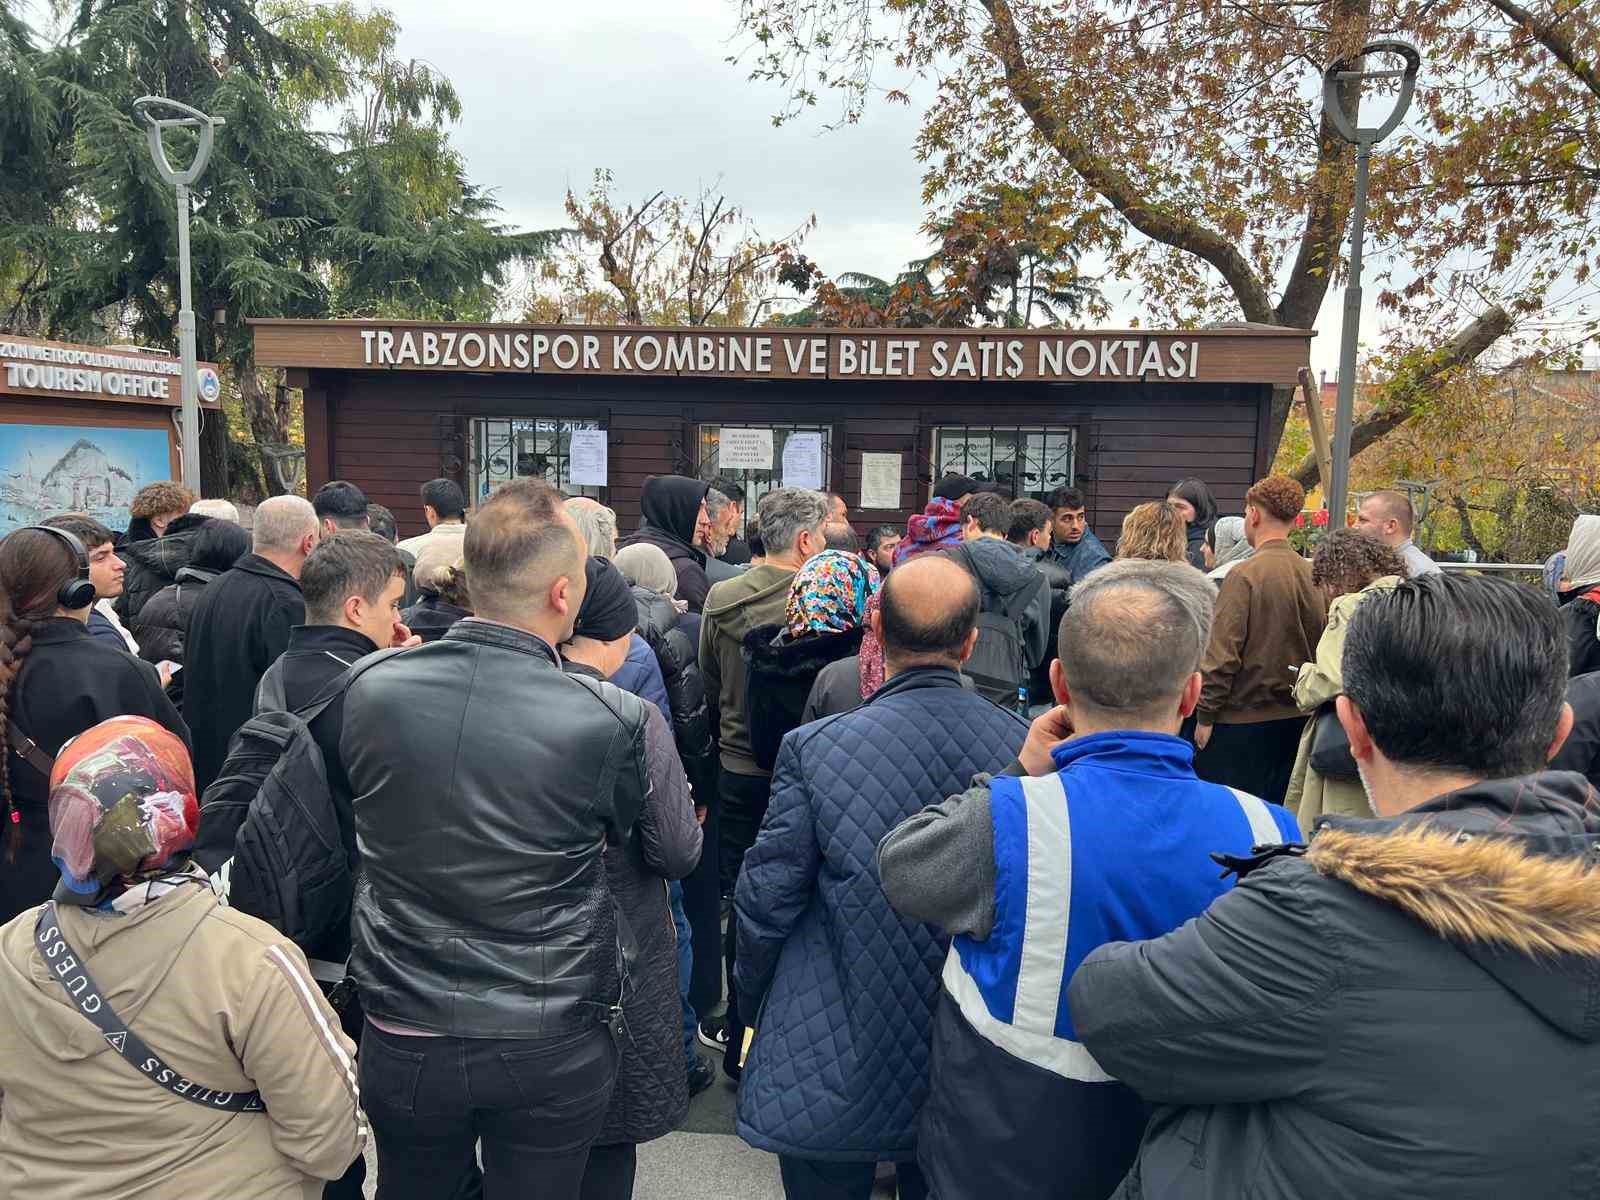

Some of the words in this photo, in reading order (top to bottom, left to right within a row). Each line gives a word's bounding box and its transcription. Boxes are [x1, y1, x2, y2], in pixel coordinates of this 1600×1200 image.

[30, 345, 126, 369] METROPOLITAN
[360, 331, 600, 370] TRABZONSPOR
[783, 338, 827, 374] VE
[1039, 340, 1199, 379] NOKTASI
[4, 362, 102, 393] TOURISM
[103, 371, 170, 399] OFFICE
[39, 926, 102, 1013] GUESS
[140, 1057, 233, 1105] GUESS
